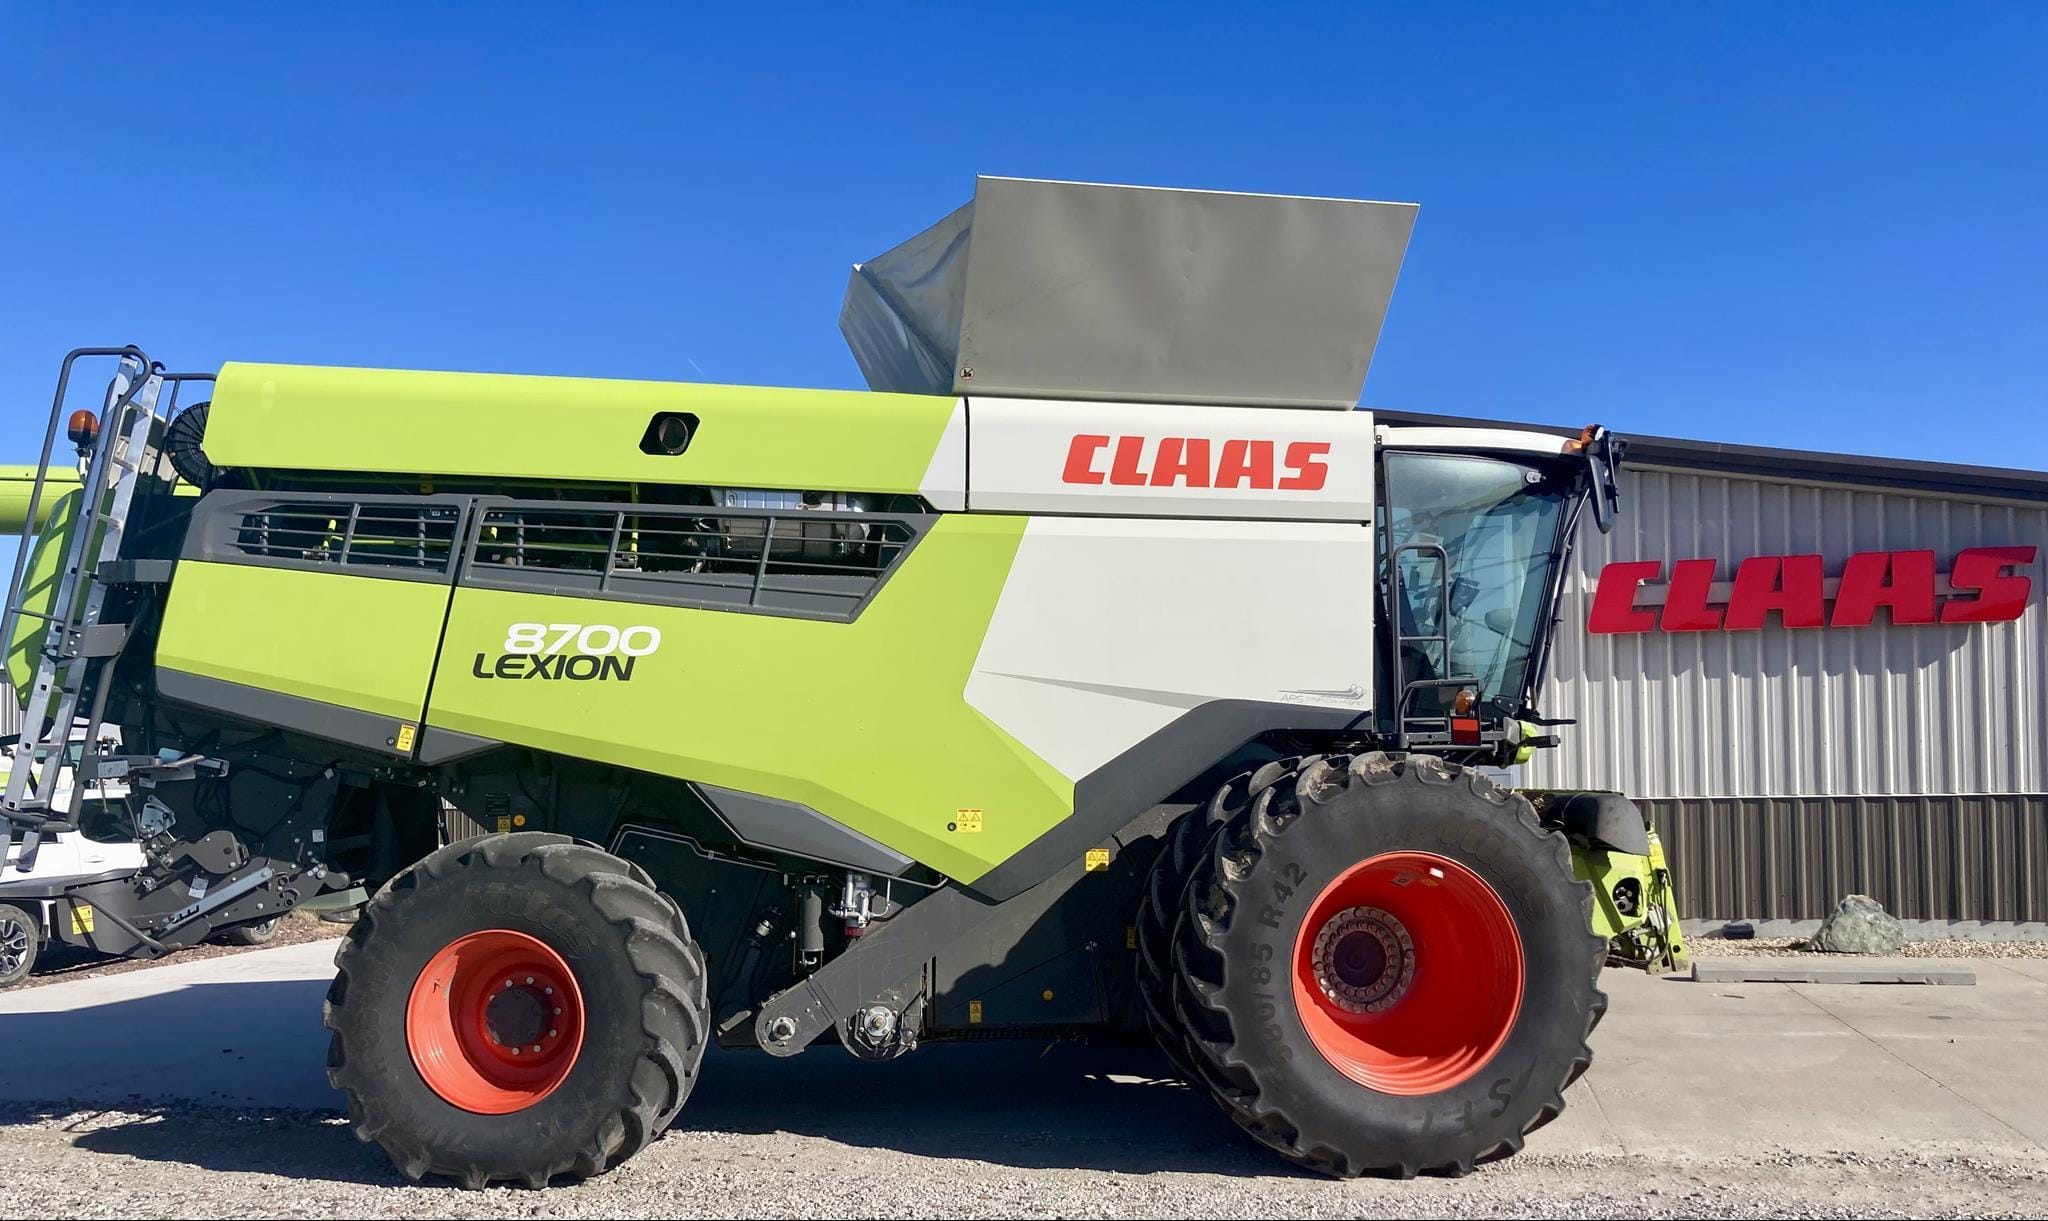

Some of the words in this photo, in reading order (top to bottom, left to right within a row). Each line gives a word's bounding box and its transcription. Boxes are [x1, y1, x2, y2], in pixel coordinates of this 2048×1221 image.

[1062, 434, 1331, 491] CLAAS
[1587, 546, 2037, 634] CLAAS
[472, 653, 636, 681] LEXION
[504, 623, 661, 656] 8700
[1257, 904, 1285, 930] R
[1272, 861, 1308, 904] 42
